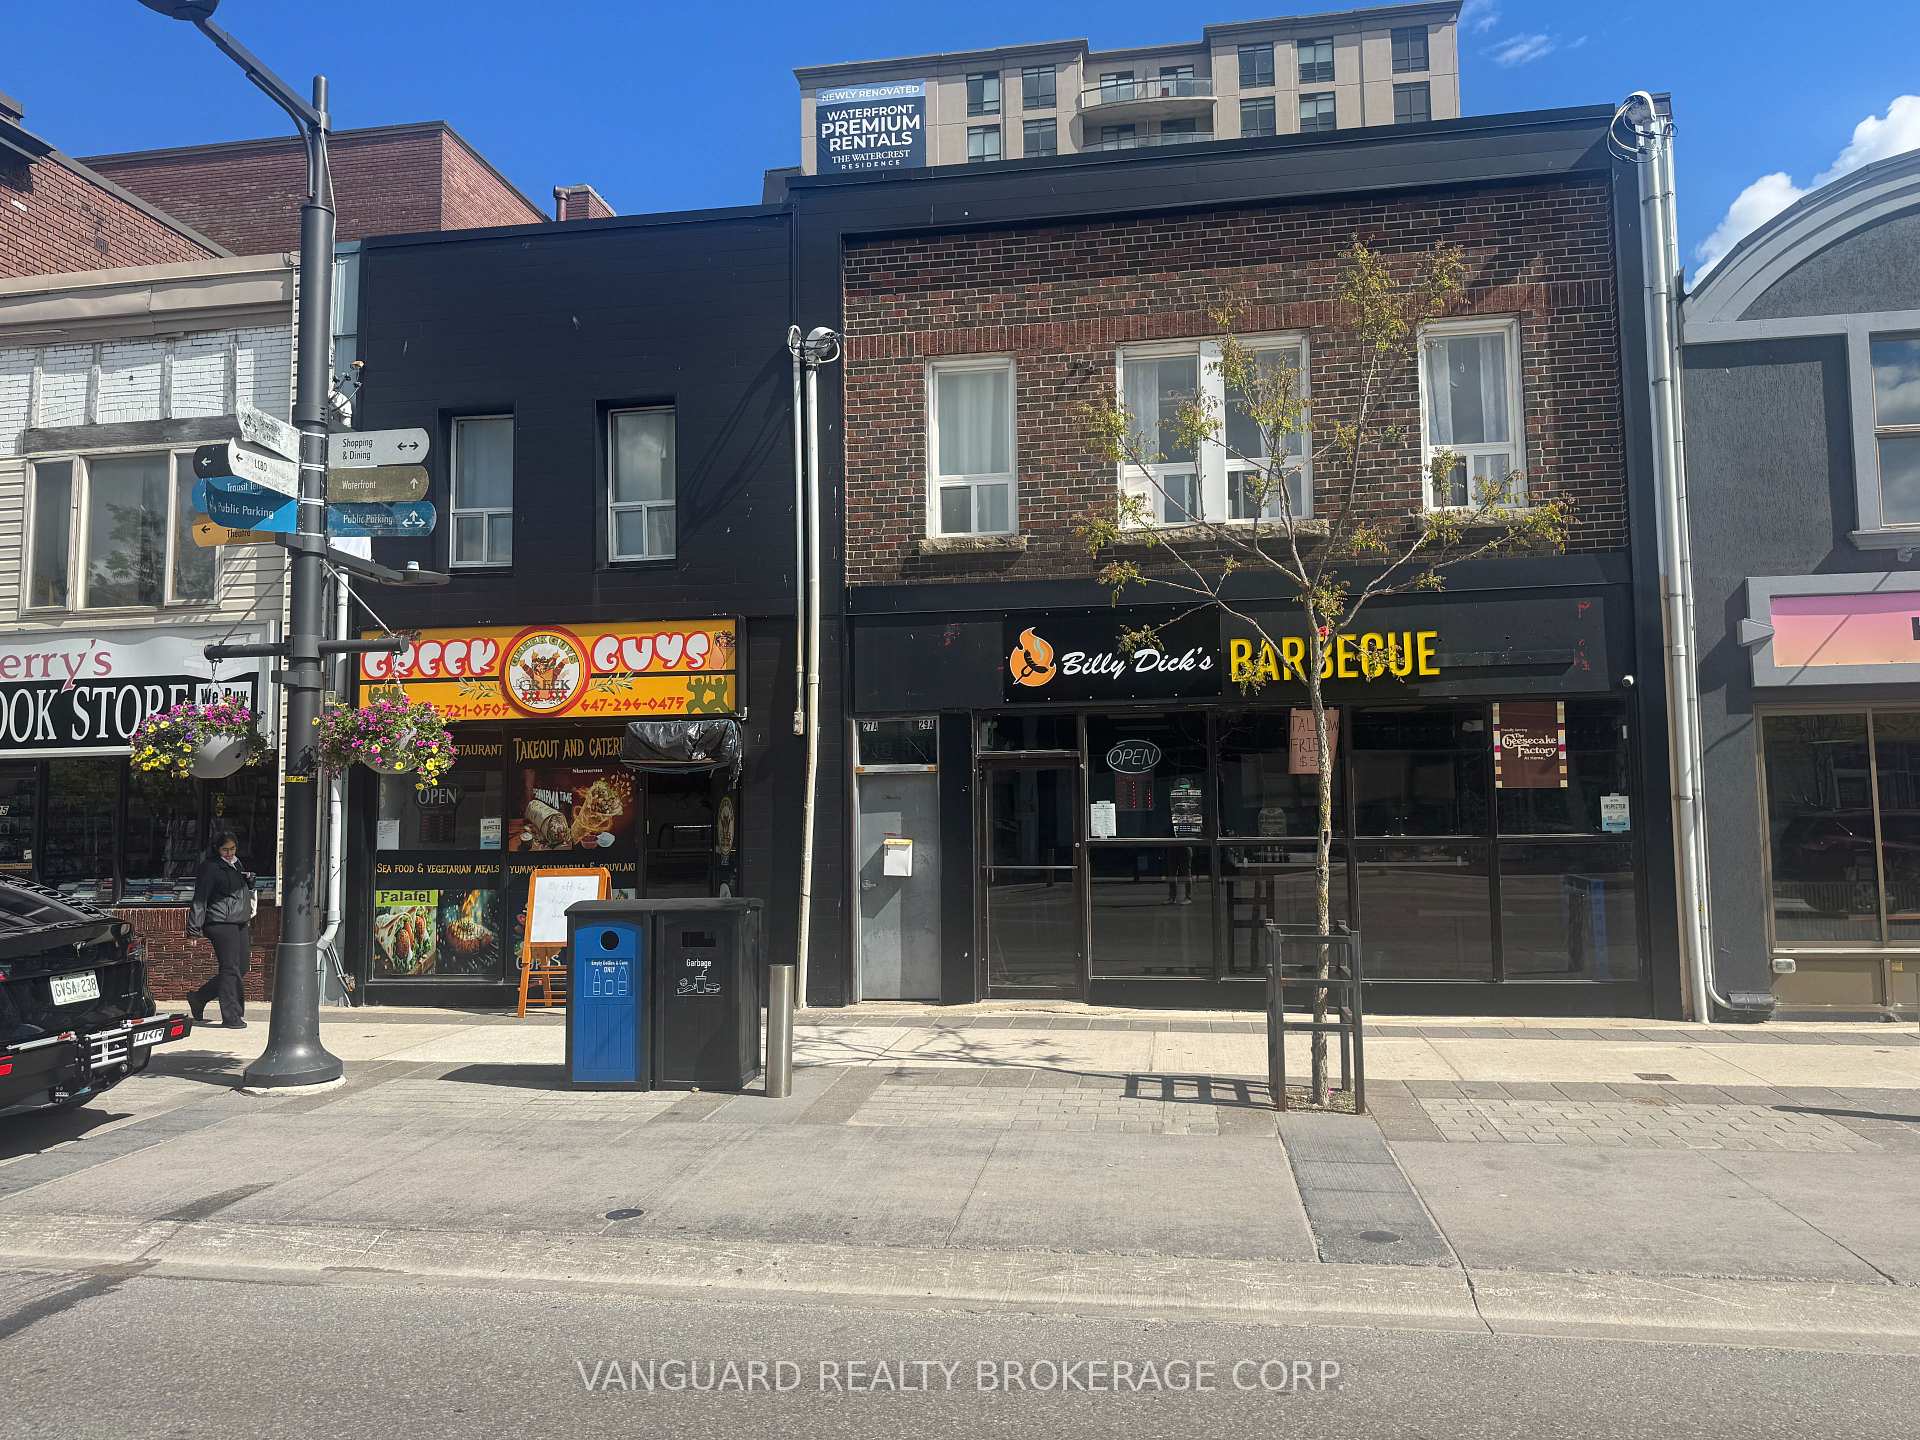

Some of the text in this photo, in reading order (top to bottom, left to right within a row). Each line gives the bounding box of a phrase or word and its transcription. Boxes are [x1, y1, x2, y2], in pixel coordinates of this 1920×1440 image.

[822, 85, 920, 102] NEWLY RENOVATED
[827, 104, 915, 120] WATERFRONT
[822, 114, 920, 138] PREMIUM
[830, 132, 912, 152] RENTALS
[832, 150, 910, 164] THE WATERCREST
[842, 160, 900, 170] RESIDENCE
[342, 438, 373, 448] Shopping
[342, 451, 371, 460] & Dining
[254, 458, 268, 472] LCBO
[227, 482, 248, 492] Transit
[342, 480, 376, 490] Waterfront
[218, 502, 274, 520] Public Parking
[343, 514, 392, 525] Public Parking
[362, 631, 710, 679] GREEK GUYS
[511, 636, 578, 666] GREEK GUYS
[1230, 630, 1440, 682] BARBECUE
[0, 640, 112, 693] erry's
[1062, 647, 1214, 680] Billy Dick's
[201, 688, 218, 704] We
[580, 696, 684, 712] 647-296-0475
[863, 722, 878, 732] 27A
[918, 720, 934, 730] 29A
[1290, 737, 1332, 752] FRIE
[1502, 734, 1556, 748] Cheesecake
[455, 744, 504, 756] STAURANT
[513, 736, 624, 764] TAKEOUT AND CATERI
[1110, 748, 1156, 766] OPEN
[1518, 746, 1556, 758] Factory
[418, 788, 456, 804] OPEN
[376, 863, 500, 874] SEA FOOD & VEGETARIAN MEALS
[510, 864, 538, 874] YUMMY
[600, 862, 636, 873] SOUVLAKI
[380, 891, 430, 903] Falafel
[686, 958, 712, 970] Garbage
[54, 978, 97, 998] GVSA 238
